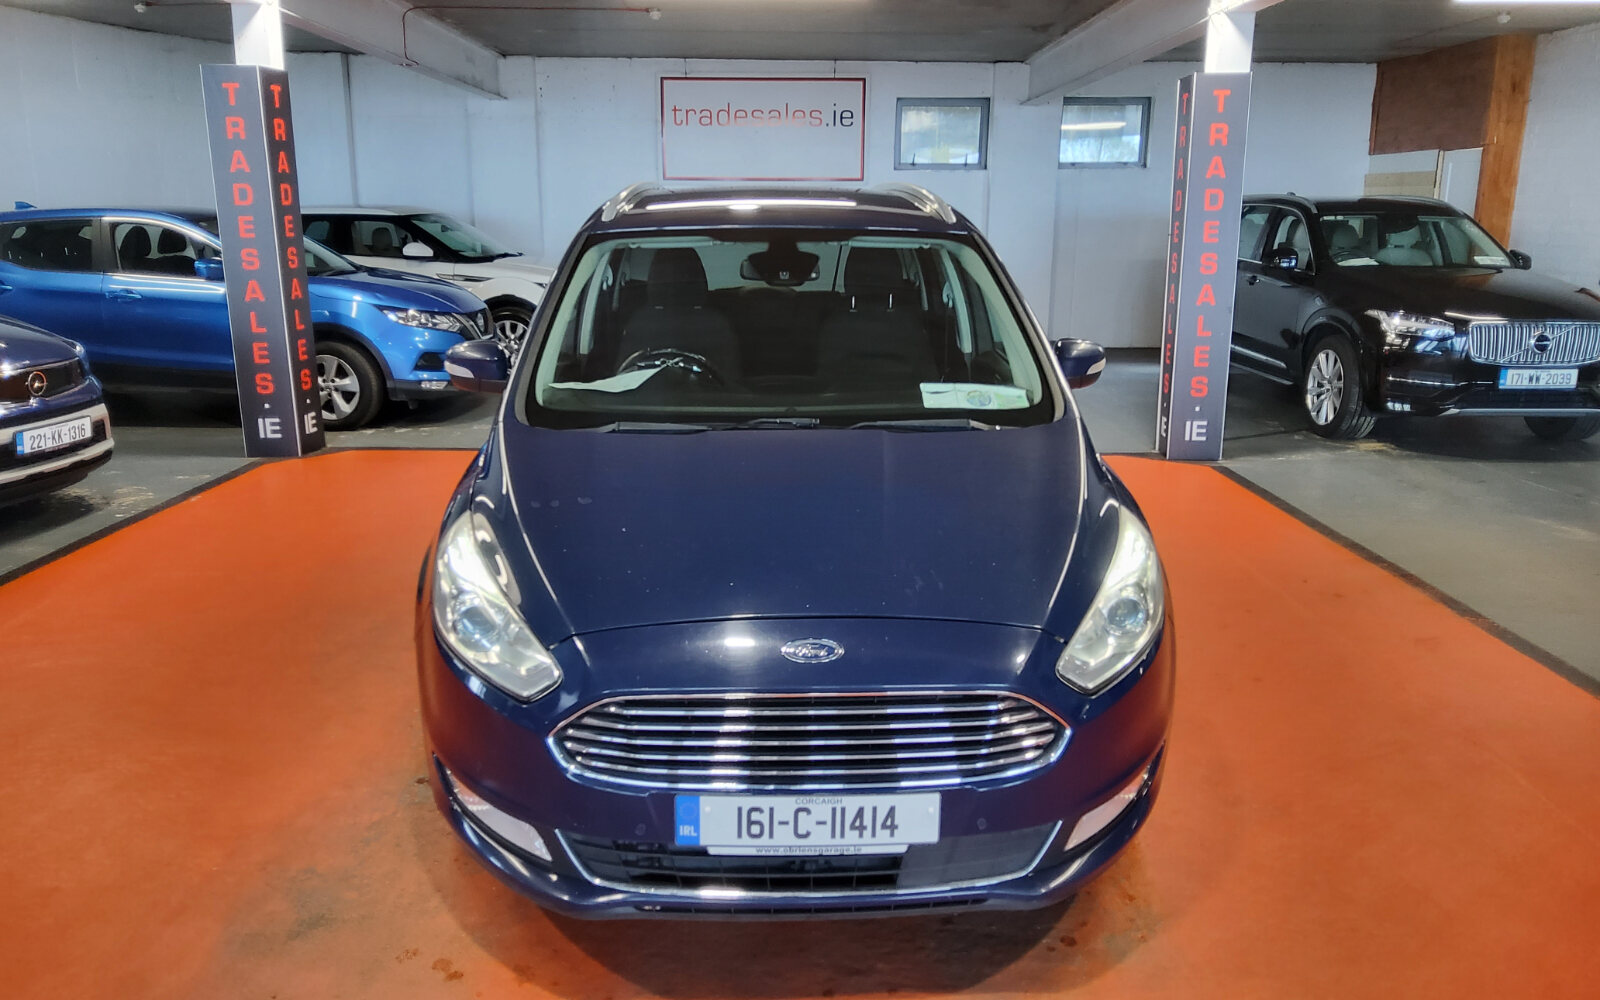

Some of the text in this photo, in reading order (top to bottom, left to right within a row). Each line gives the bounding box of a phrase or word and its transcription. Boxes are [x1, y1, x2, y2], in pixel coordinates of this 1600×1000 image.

[672, 102, 854, 127] tradesales.ie
[29, 423, 86, 451] 221-KK-1316
[795, 797, 843, 805] CORCAIGH
[679, 825, 698, 837] IRL
[736, 805, 899, 840] 161-C-11414
